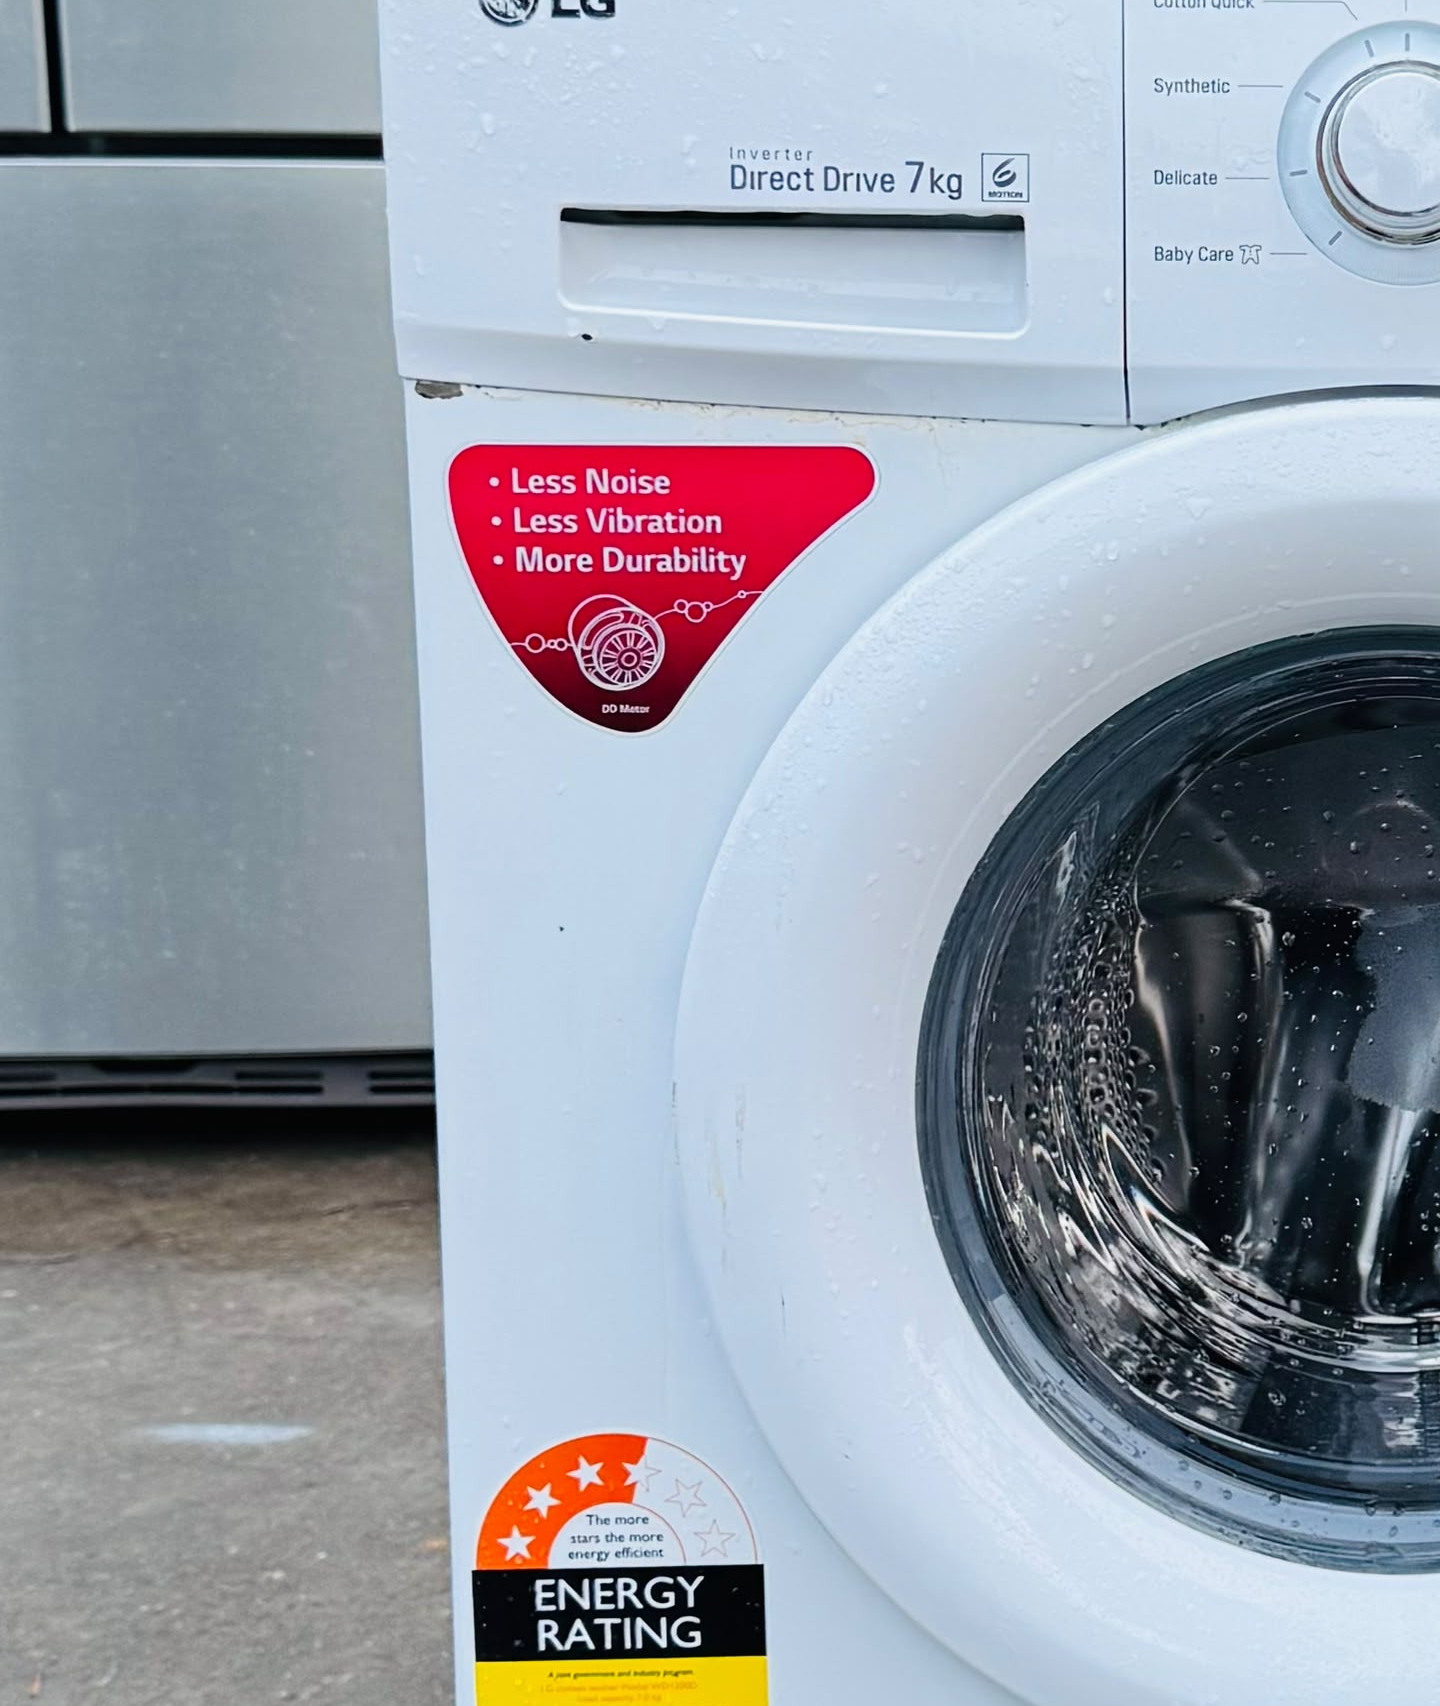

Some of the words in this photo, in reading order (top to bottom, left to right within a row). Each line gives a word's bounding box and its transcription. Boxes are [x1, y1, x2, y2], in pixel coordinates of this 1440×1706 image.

[1153, 78, 1231, 97] Synthetic
[729, 146, 814, 161] Inverter
[730, 165, 815, 192] Direct
[823, 166, 896, 193] Drive
[1154, 170, 1218, 186] Delicate
[1154, 246, 1194, 265] Baby
[1198, 246, 1234, 262] Care
[511, 467, 577, 494] Less
[586, 467, 671, 494] Noise
[513, 507, 578, 533] Less
[586, 507, 722, 534] Vibration
[516, 546, 593, 572] More
[602, 546, 747, 581] Durability
[602, 704, 618, 713] DD
[586, 1514, 611, 1526] The
[615, 1515, 649, 1525] more
[570, 1534, 601, 1544] stars
[605, 1532, 625, 1543] the
[629, 1533, 664, 1543] more
[568, 1549, 609, 1562] energy
[615, 1547, 664, 1559] efficient
[534, 1576, 704, 1612] ENERGY
[537, 1615, 702, 1652] RATING
